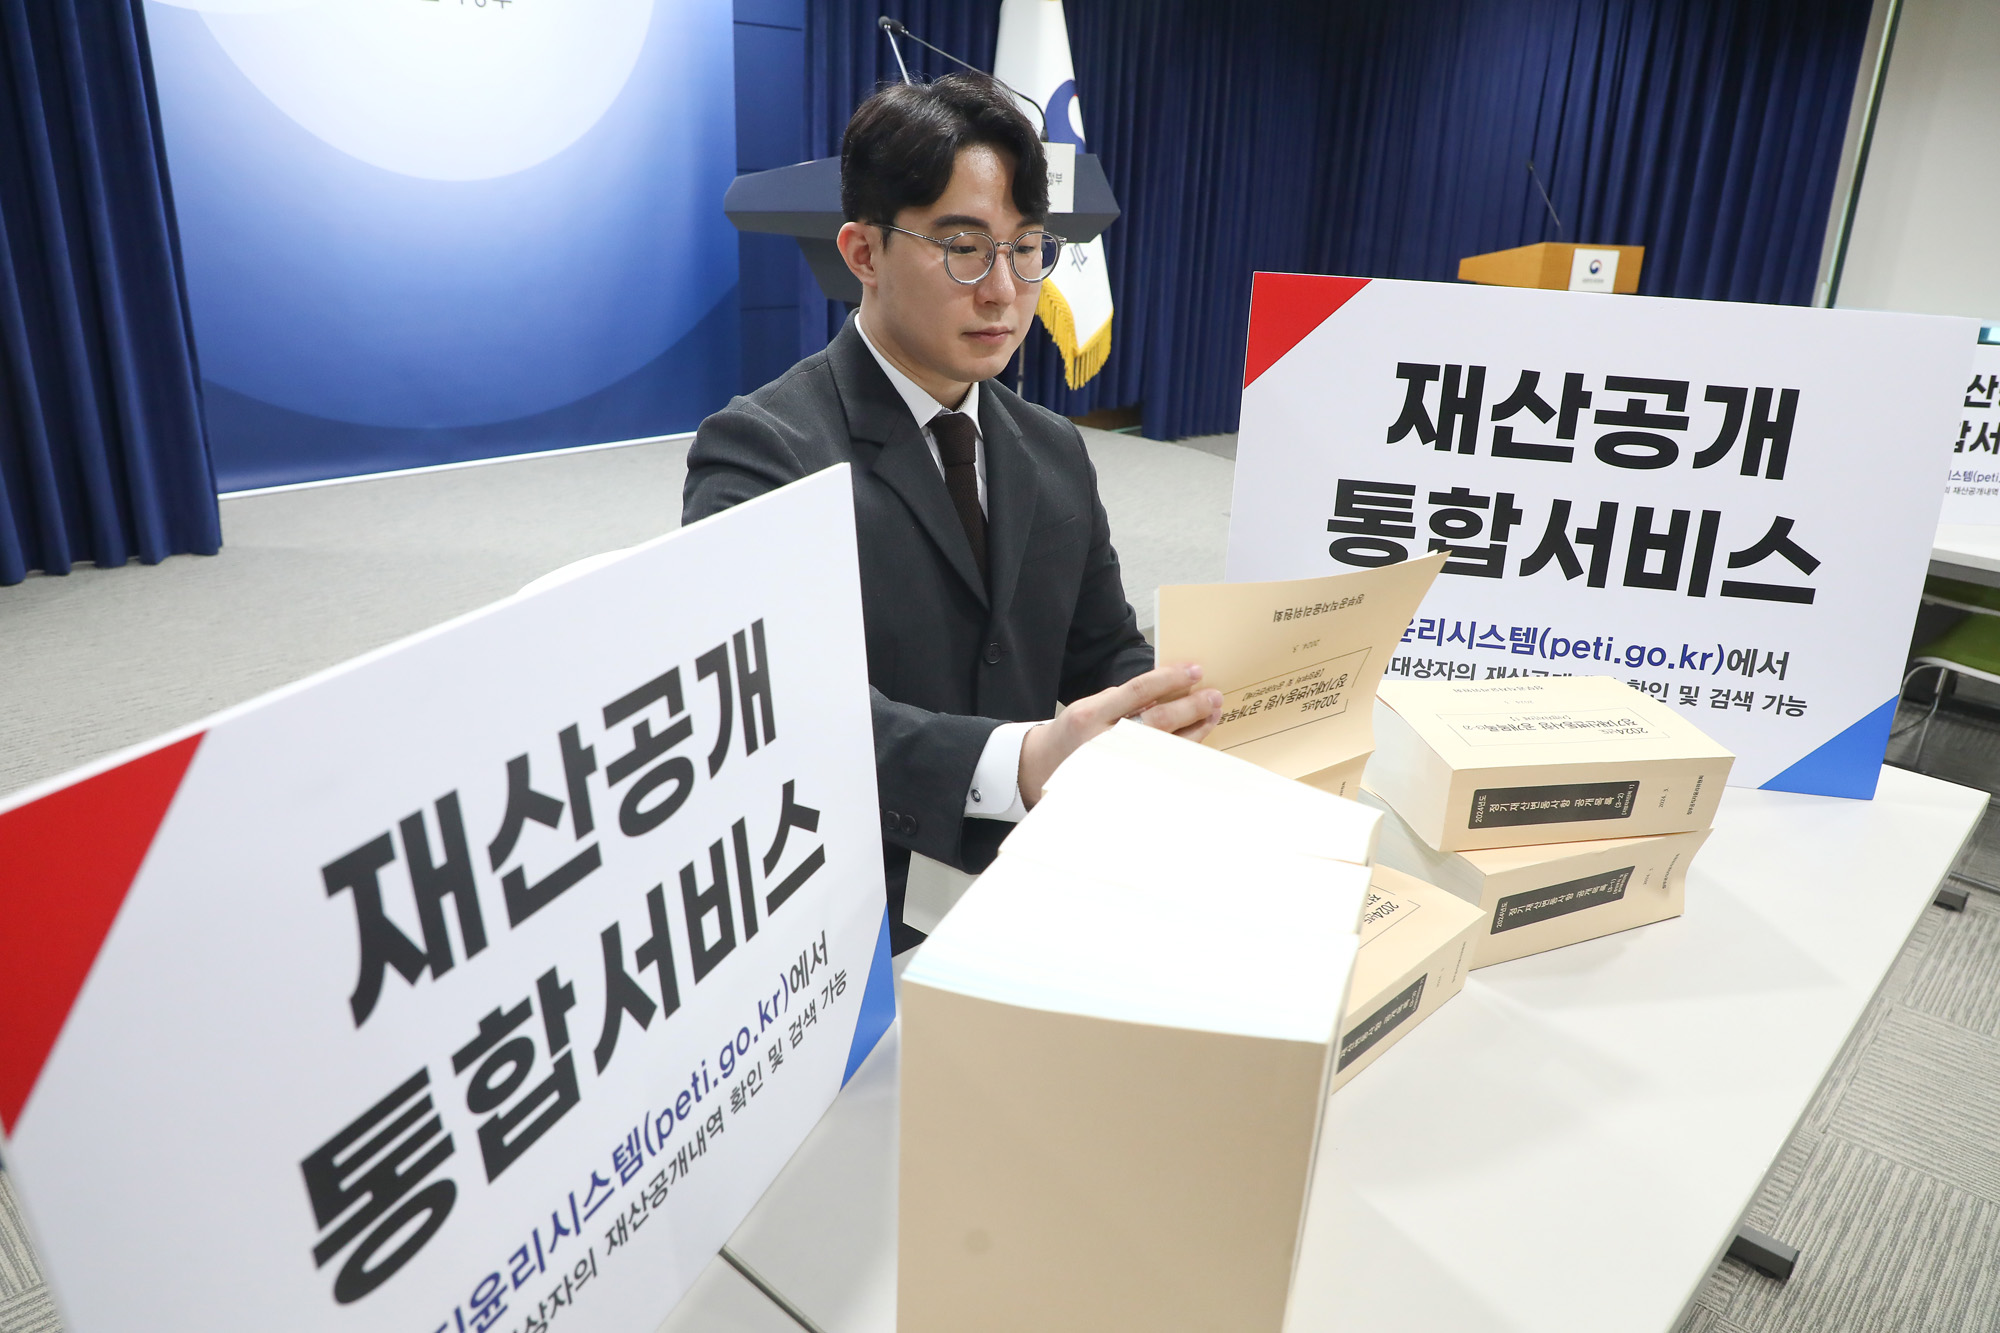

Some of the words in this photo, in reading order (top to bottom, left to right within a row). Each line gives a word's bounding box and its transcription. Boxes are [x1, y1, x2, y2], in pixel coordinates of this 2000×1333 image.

[1963, 374, 2000, 409] 산
[1387, 361, 1801, 481] 재산공개
[1327, 478, 1822, 605] 통합서비스
[1273, 593, 1365, 623] 정부공직자윤리위원회
[1384, 656, 1477, 681] 대상자의
[1264, 673, 1349, 712] 정기재산변동사항
[1301, 692, 1342, 713] 2024년도
[1678, 685, 1701, 706] 및
[1709, 687, 1755, 712] 검색
[1762, 694, 1808, 718] 가능
[1475, 794, 1488, 824] 2024년도
[1489, 798, 1572, 813] 정기재산변동사항
[1574, 796, 1615, 808] 공개목록
[320, 617, 777, 1031] 재산공개
[1496, 901, 1509, 929] 2024년도
[299, 778, 827, 1305] 통합서비스
[511, 1247, 599, 1333] 상자의
[605, 1105, 725, 1255] 재산공개내역
[729, 1061, 764, 1114] 확인
[768, 1037, 784, 1074] 및
[788, 998, 818, 1050] 검색
[821, 969, 847, 1010] 가능
